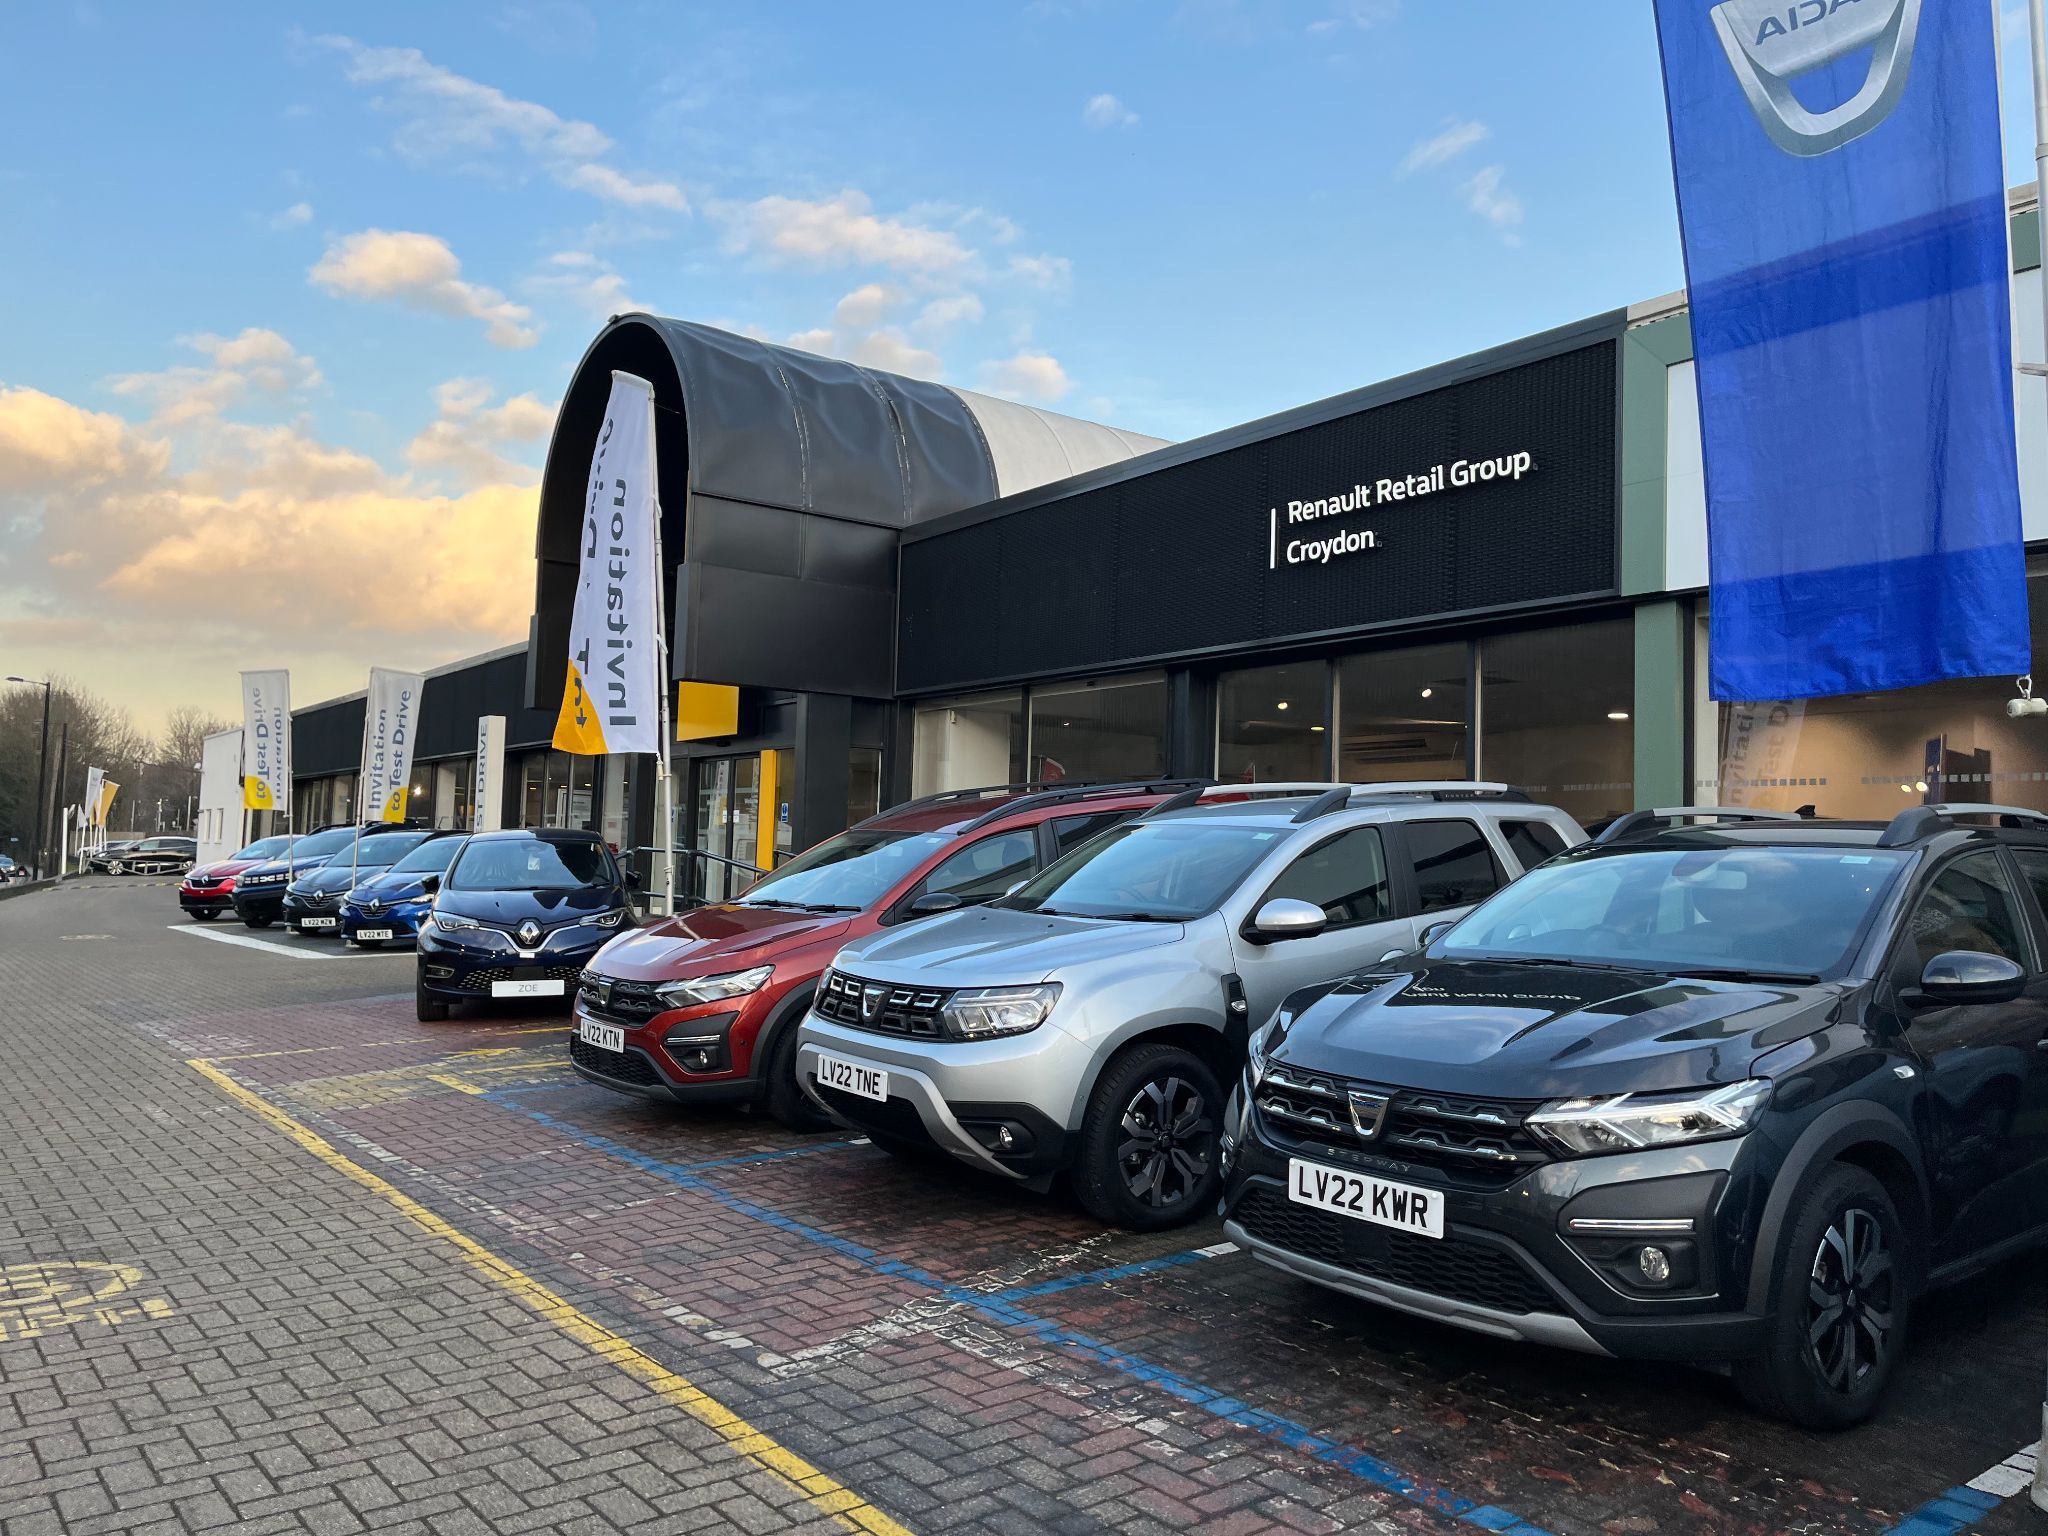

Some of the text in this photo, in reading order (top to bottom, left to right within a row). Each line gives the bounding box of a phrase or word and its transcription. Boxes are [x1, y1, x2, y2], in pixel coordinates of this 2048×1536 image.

[1288, 451, 1531, 524] Renault Retail Group
[1287, 530, 1375, 564] Croydon
[368, 709, 387, 809] Invitation
[389, 690, 411, 811] to Test Drive
[478, 723, 488, 793] DRIVE
[518, 984, 539, 993] ZOE
[582, 1022, 620, 1049] LV22 KTN
[821, 1057, 881, 1096] LV22 TNE
[1298, 1166, 1428, 1228] LV22 KWR
